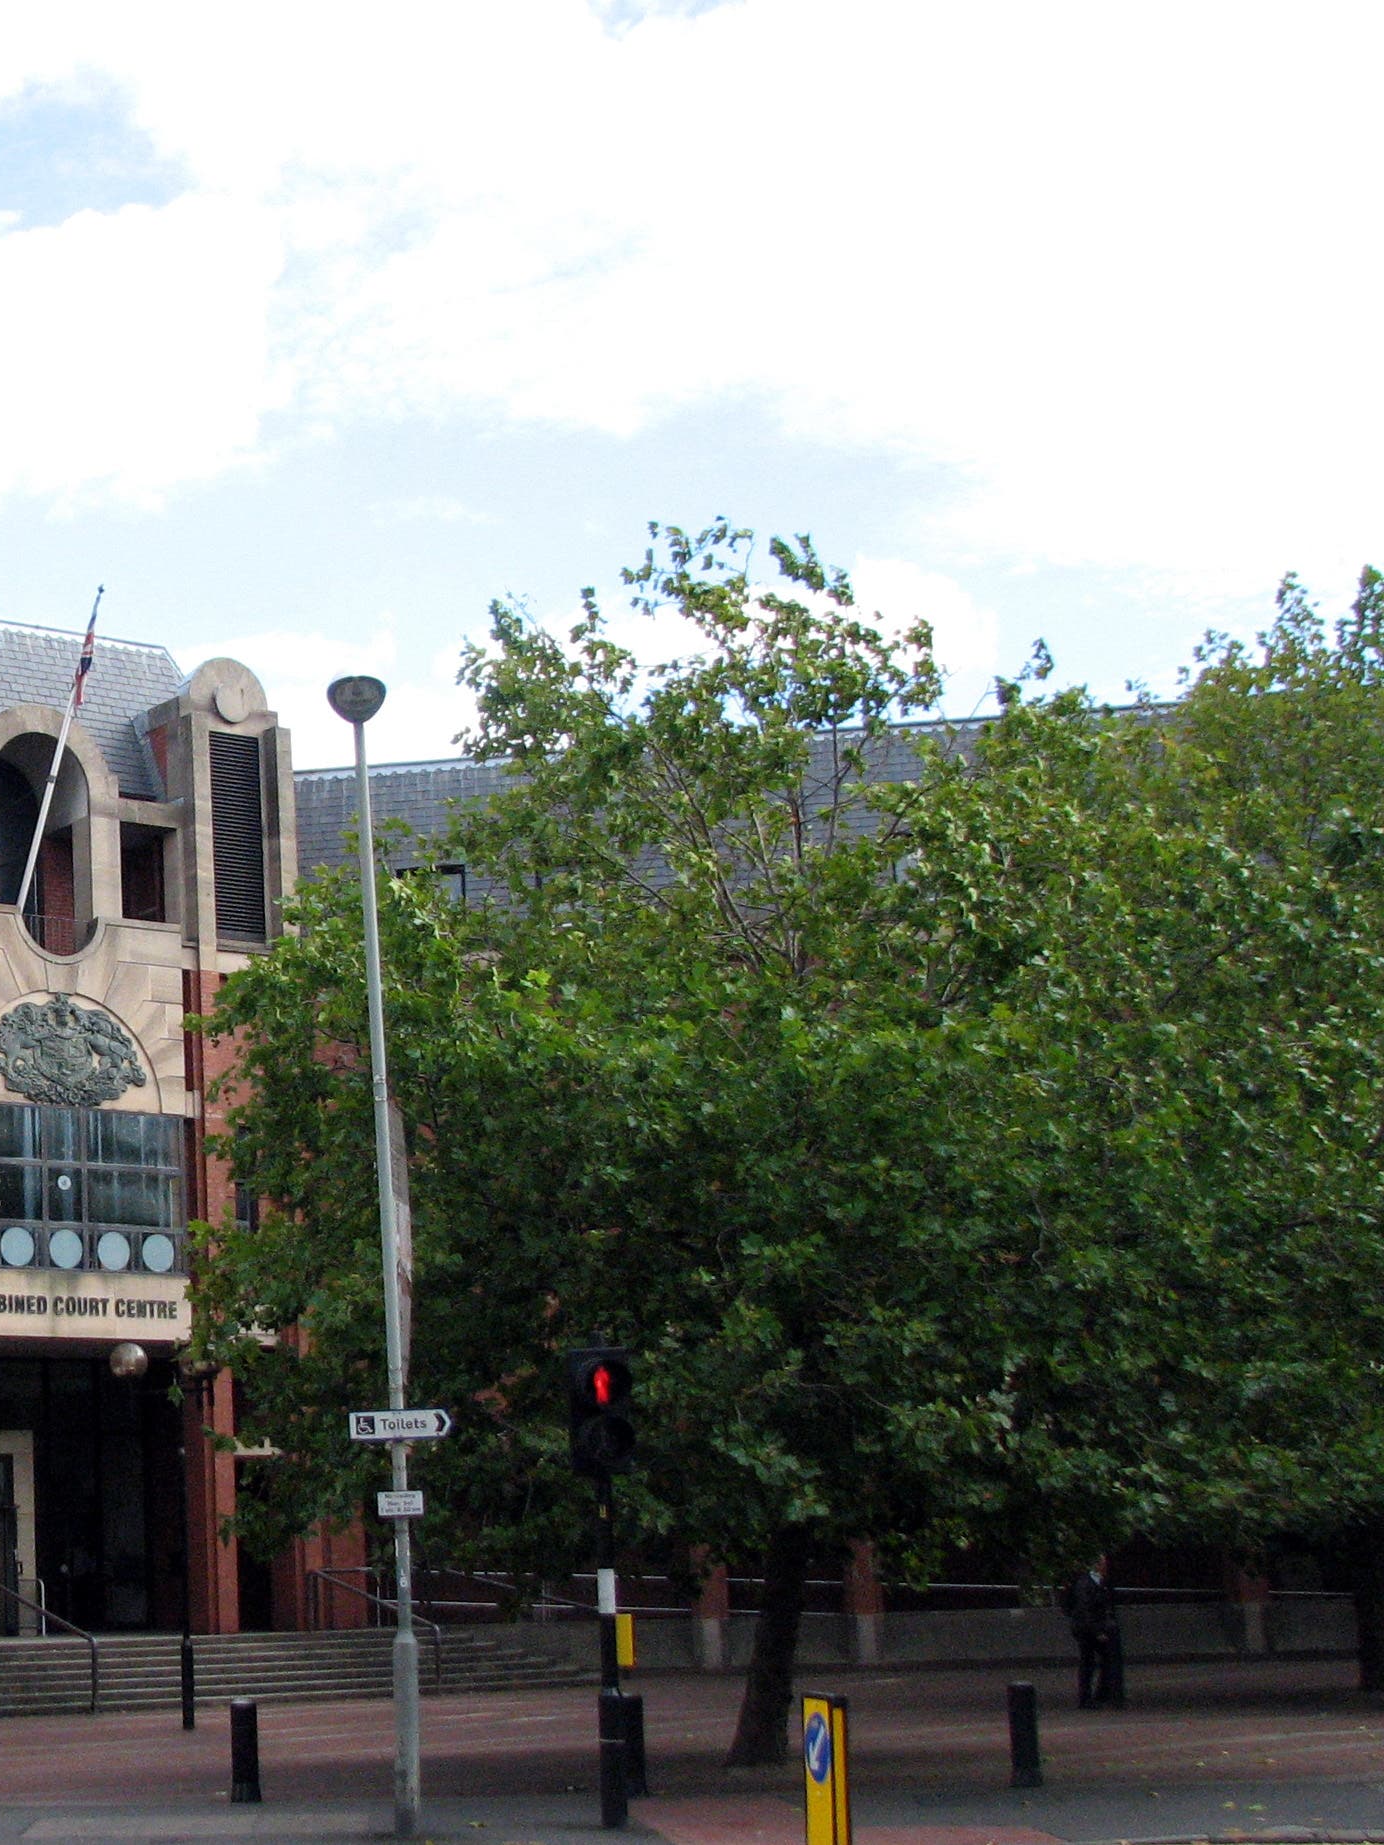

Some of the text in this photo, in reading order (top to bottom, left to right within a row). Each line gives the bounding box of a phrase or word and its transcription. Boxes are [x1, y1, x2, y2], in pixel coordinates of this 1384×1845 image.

[53, 1296, 110, 1317] COURT
[115, 1298, 178, 1320] CENTRE
[380, 1418, 427, 1430] Toilets
